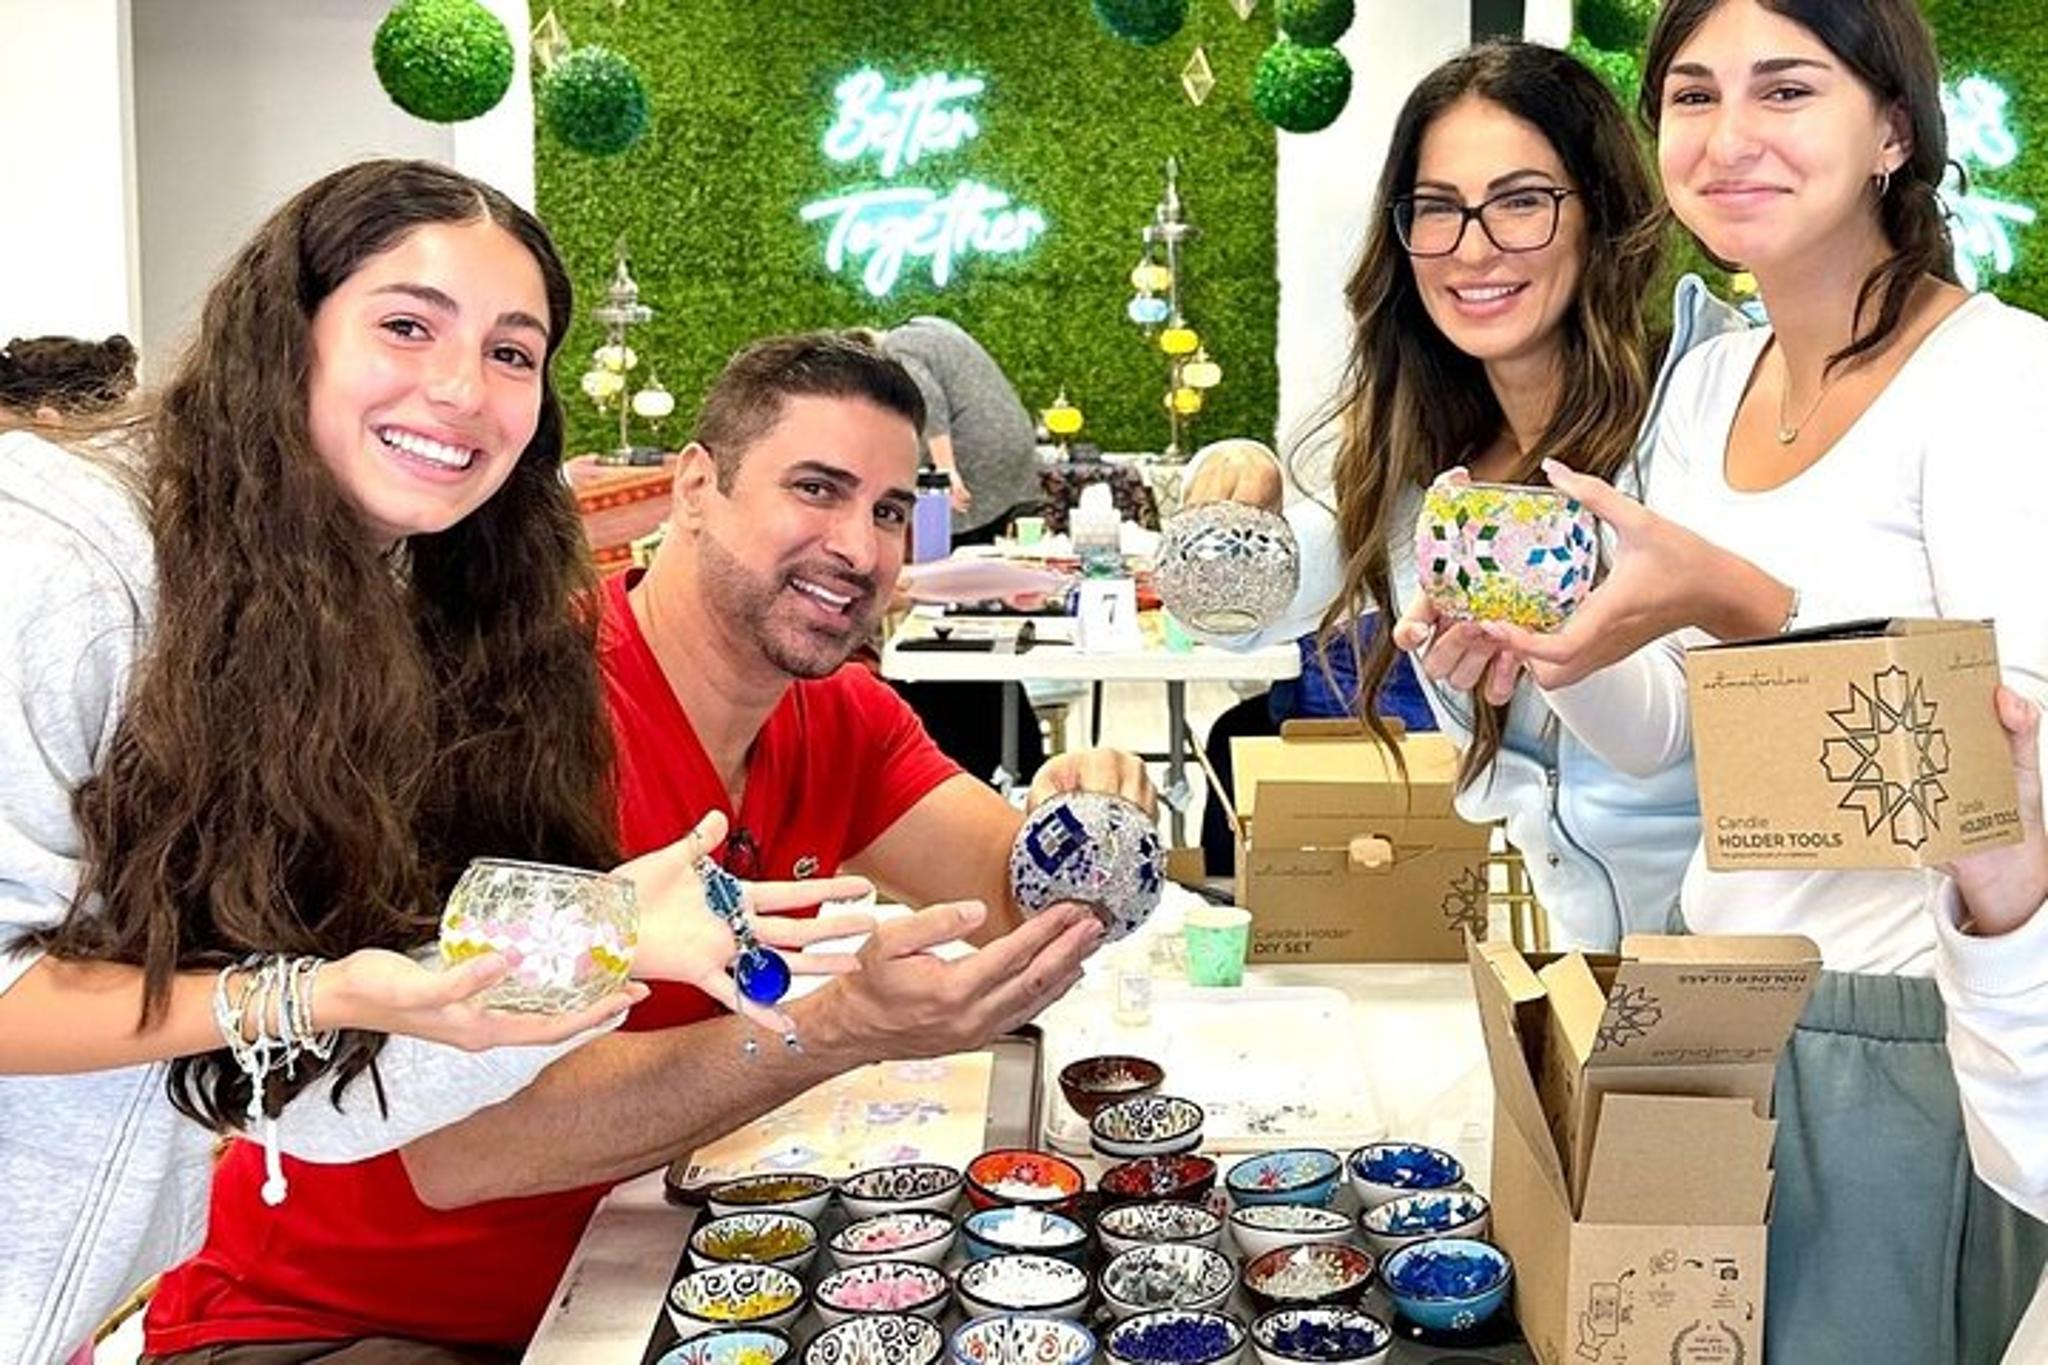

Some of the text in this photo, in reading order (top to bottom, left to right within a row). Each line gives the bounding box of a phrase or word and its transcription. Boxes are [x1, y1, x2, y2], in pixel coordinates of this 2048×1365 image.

[823, 70, 985, 177] Better
[799, 180, 1046, 296] Together
[1101, 593, 1118, 625] 7
[1717, 815, 1770, 831] Candle
[1717, 832, 1844, 849] HOLDER TOOLS
[1254, 941, 1312, 954] DIY SET
[1736, 974, 1808, 986] HOLDER
